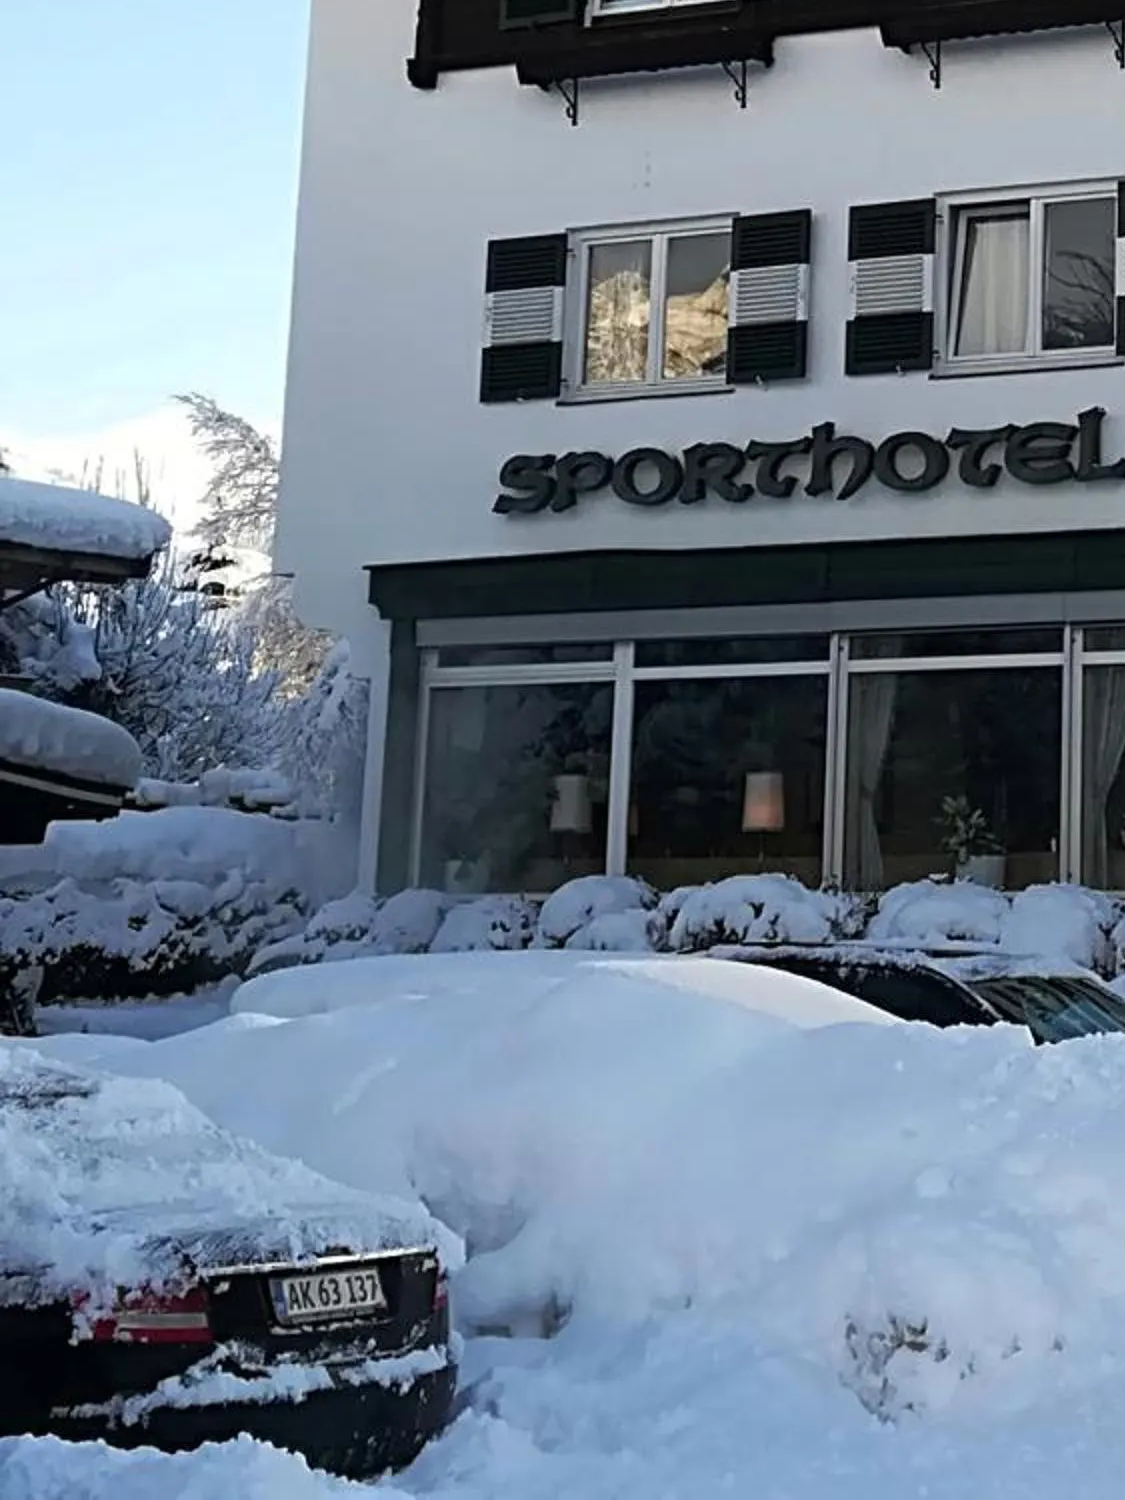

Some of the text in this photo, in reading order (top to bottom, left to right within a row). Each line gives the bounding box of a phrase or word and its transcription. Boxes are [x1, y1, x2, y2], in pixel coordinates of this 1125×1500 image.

[288, 1273, 378, 1310] AK 63 137
